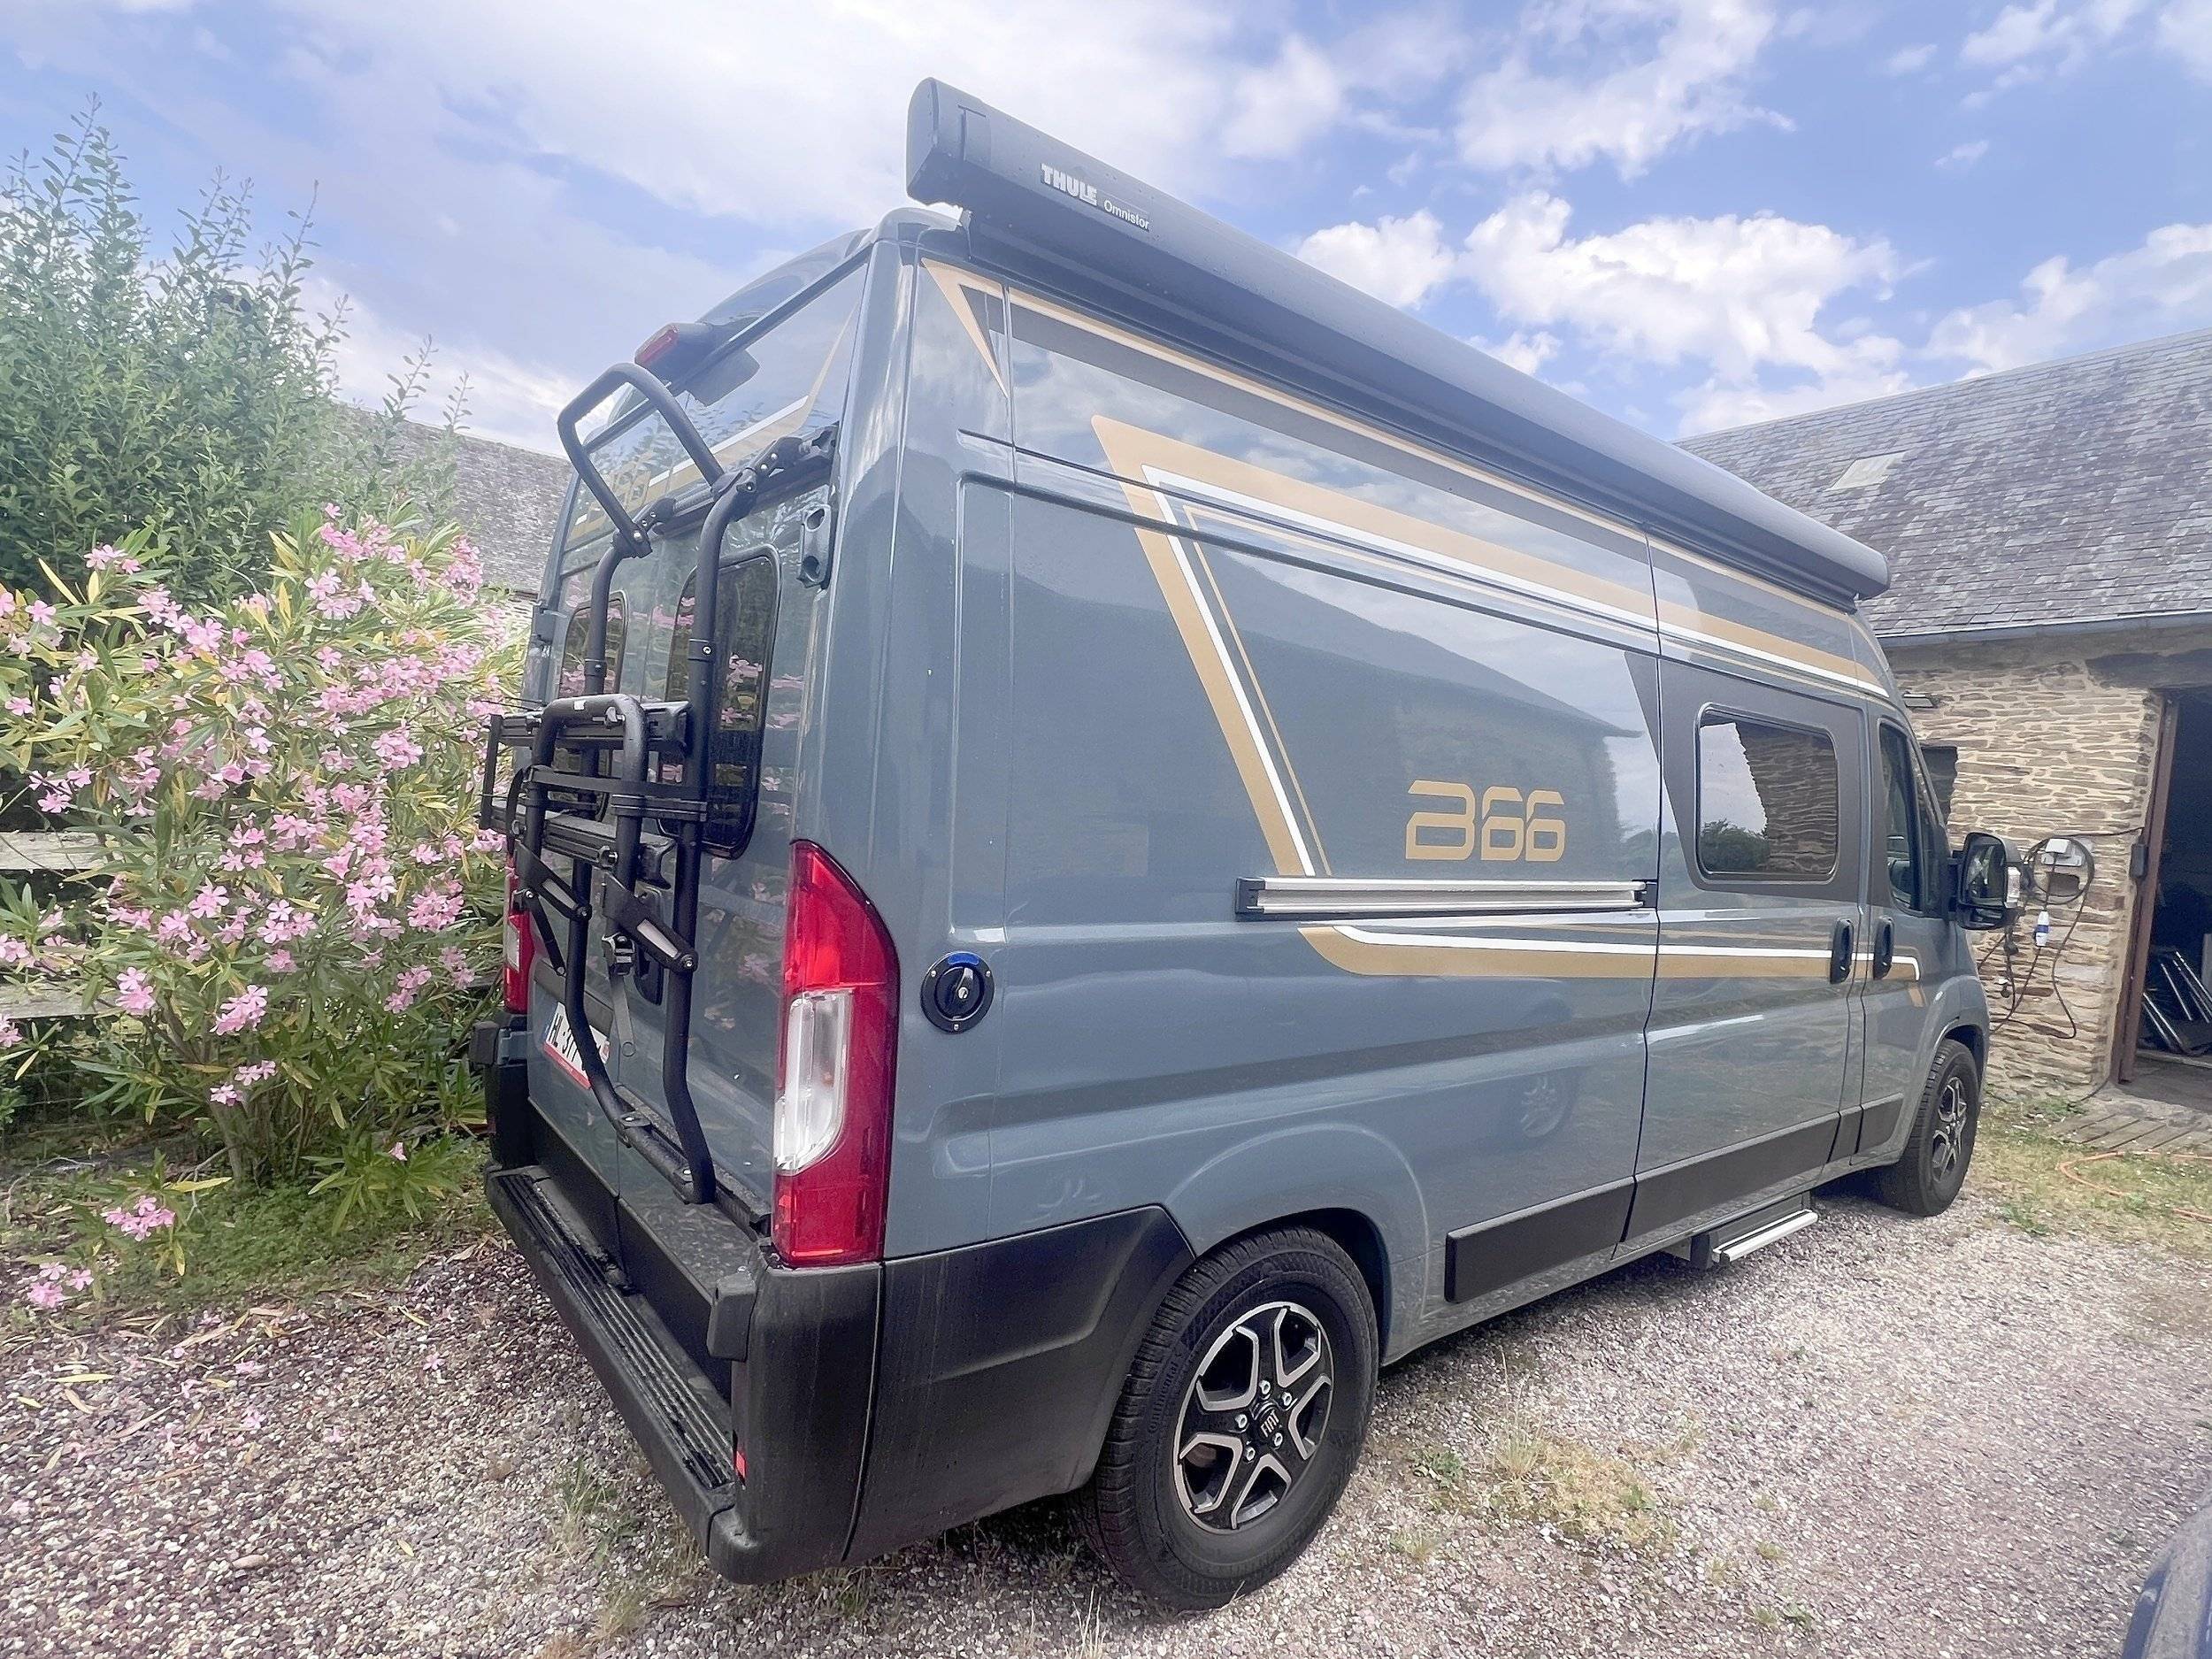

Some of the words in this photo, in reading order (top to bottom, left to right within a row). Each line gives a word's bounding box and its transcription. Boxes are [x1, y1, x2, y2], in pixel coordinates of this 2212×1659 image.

[1041, 163, 1097, 207] THULE
[1103, 199, 1150, 230] Omnistor
[1260, 1409, 1279, 1438] FIAT
